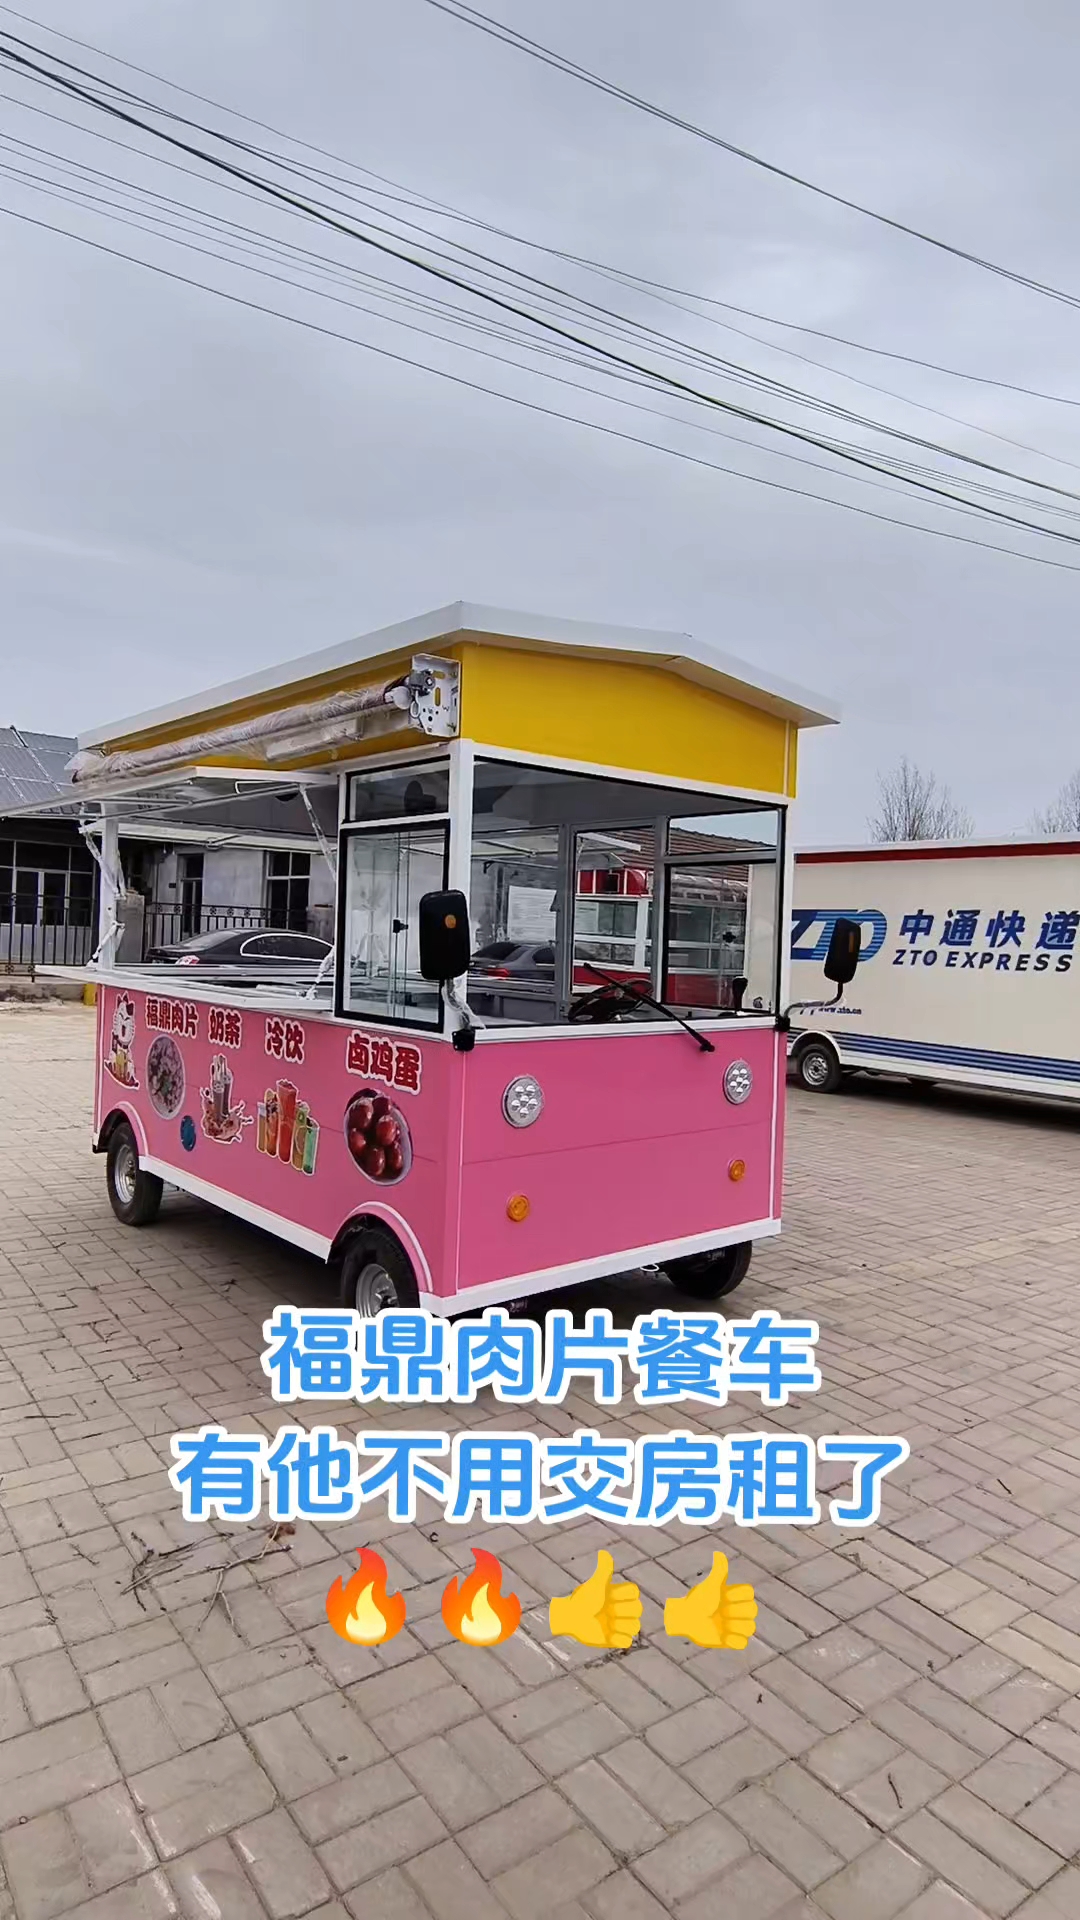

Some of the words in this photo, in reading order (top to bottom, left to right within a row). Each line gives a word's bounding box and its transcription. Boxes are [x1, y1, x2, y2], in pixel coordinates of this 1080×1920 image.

[790, 909, 887, 962] ZTO
[899, 909, 1080, 950] 中通快递
[893, 949, 938, 966] ZTO
[945, 950, 1073, 973] EXPRESS
[146, 996, 198, 1037] 福鼎肉片
[209, 1008, 242, 1047] 奶茶
[265, 1018, 304, 1062] 冷饮
[347, 1031, 421, 1092] 卤鸡蛋
